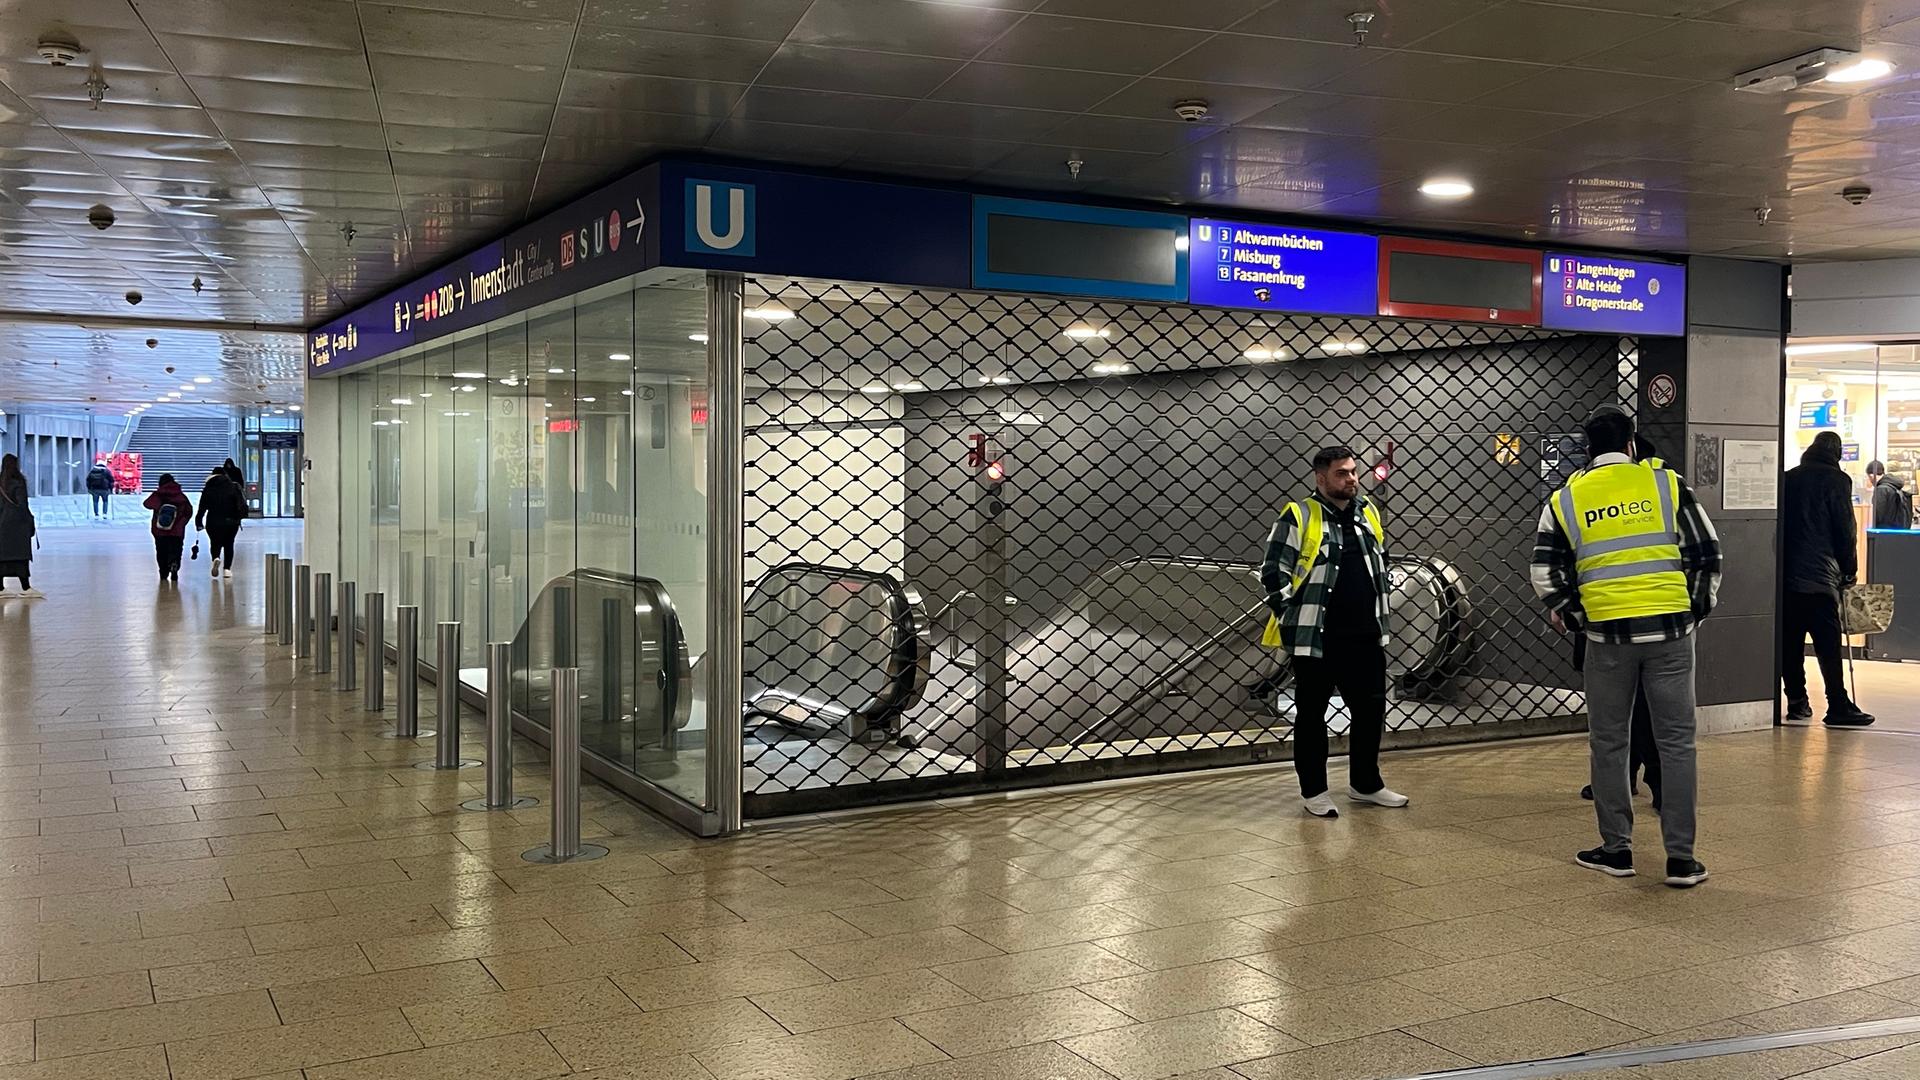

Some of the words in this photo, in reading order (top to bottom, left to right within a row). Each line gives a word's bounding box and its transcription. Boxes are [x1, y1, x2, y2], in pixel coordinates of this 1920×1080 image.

[696, 184, 745, 250] U
[580, 227, 588, 259] S
[594, 218, 604, 254] U
[1199, 224, 1212, 242] U
[1221, 229, 1229, 241] 3
[1234, 230, 1324, 251] Altwarmbüchen
[561, 234, 575, 267] DB
[1221, 248, 1228, 260] 7
[1233, 249, 1281, 270] Misburg
[470, 248, 525, 305] Innenstadt
[1549, 258, 1561, 273] U
[1567, 262, 1573, 272] 1
[1576, 262, 1636, 281] Langenhagen
[1219, 267, 1230, 279] 13
[1233, 267, 1306, 290] Fasanenkrug
[1566, 279, 1574, 289] 2
[1575, 278, 1596, 292] Alte
[1596, 281, 1623, 294] Heide
[438, 284, 454, 317] ZOB
[1565, 295, 1573, 306] 8
[1575, 295, 1645, 312] Dragonerstraße
[1585, 500, 1653, 528] protec
[1623, 515, 1655, 525] service
